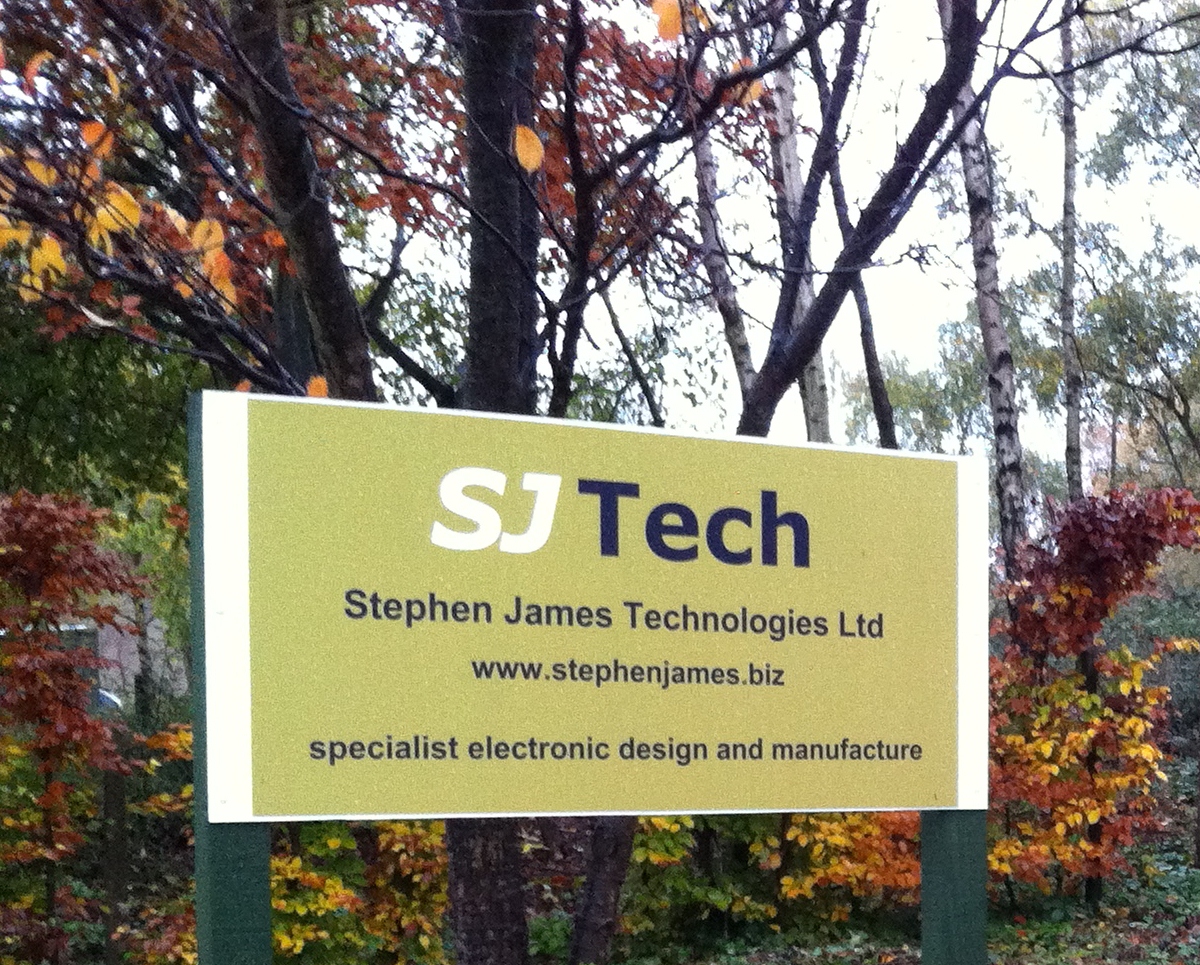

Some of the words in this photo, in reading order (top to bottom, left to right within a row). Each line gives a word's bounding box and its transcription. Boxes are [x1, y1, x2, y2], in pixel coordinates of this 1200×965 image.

[430, 466, 562, 555] SJ
[577, 478, 811, 568] Tech
[344, 588, 492, 628] Stephen
[504, 596, 612, 628] James
[624, 602, 829, 642] Technologies
[839, 611, 883, 639] Ltd
[471, 658, 786, 690] www.stephenjames.biz
[310, 735, 459, 766] specialist
[468, 735, 610, 761] electronic
[619, 738, 708, 767] design
[717, 738, 763, 761] and
[772, 738, 923, 761] manufacture
